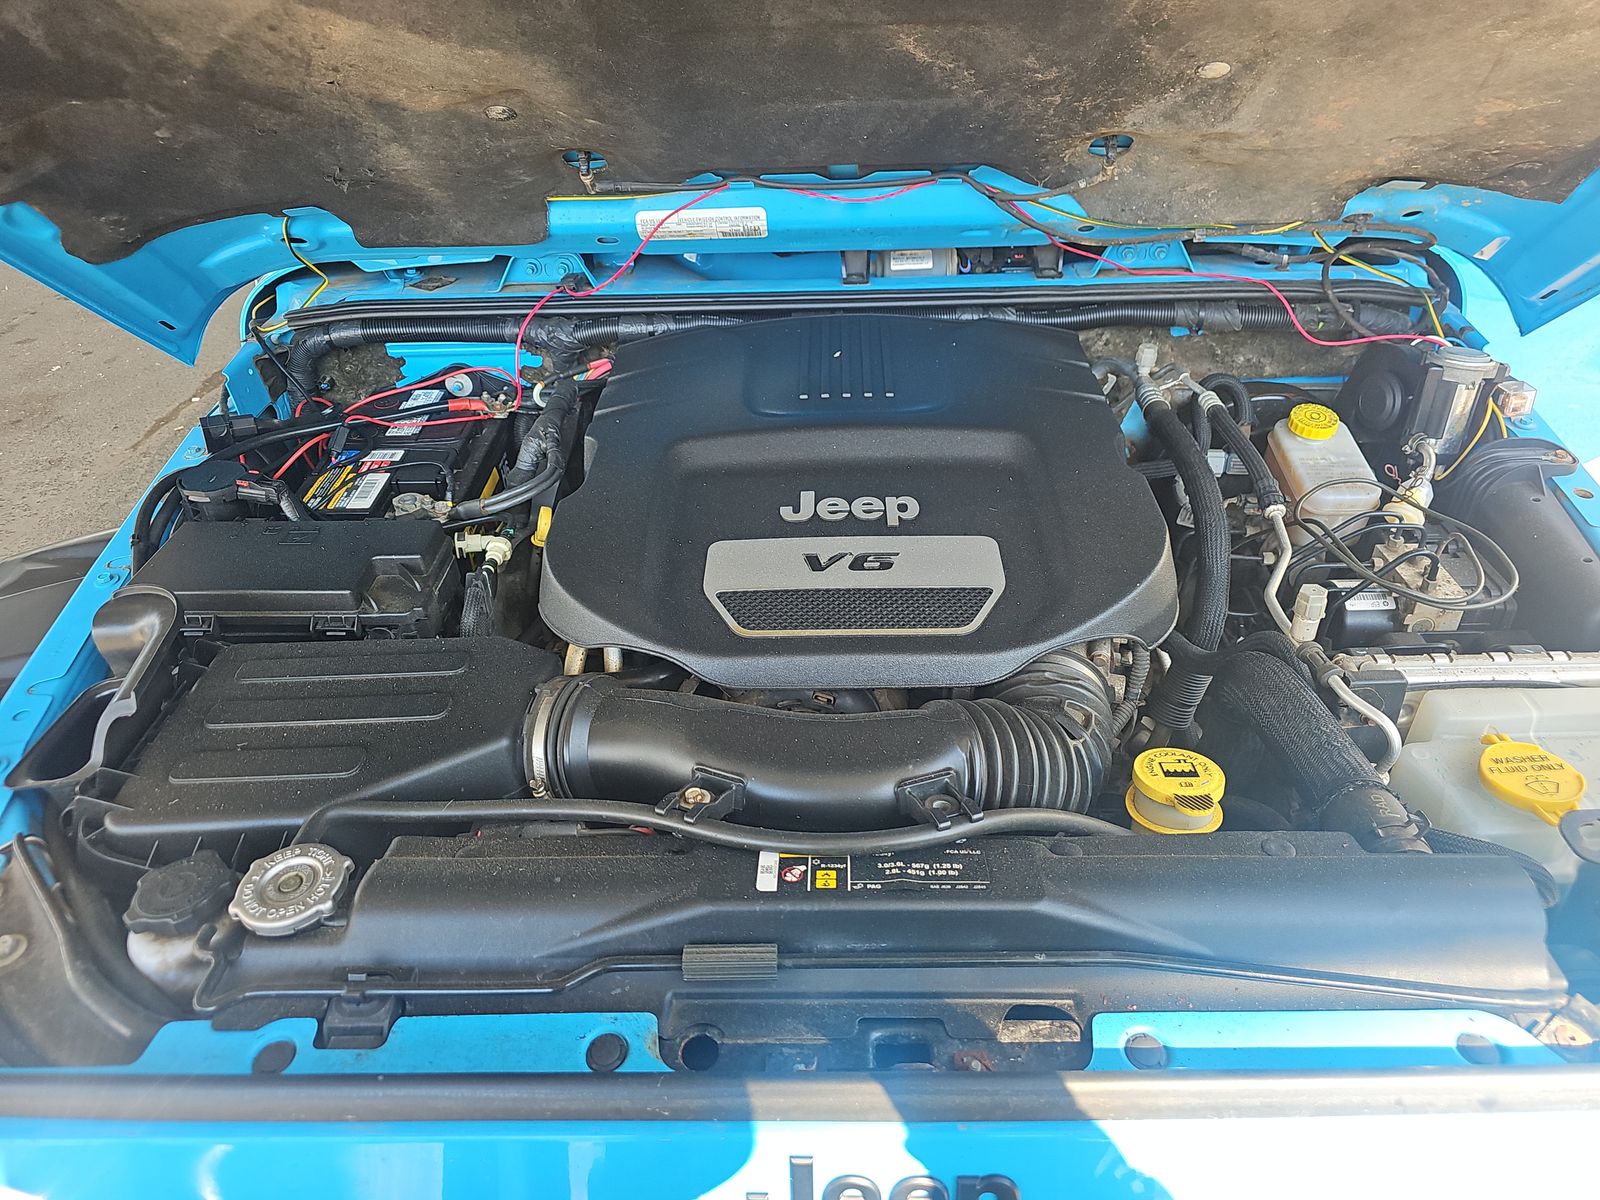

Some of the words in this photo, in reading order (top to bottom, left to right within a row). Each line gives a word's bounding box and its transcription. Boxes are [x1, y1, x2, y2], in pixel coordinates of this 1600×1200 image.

[779, 490, 921, 527] Jeep
[802, 551, 902, 573] V6
[1146, 757, 1159, 777] ENGINE
[1154, 751, 1199, 762] COOLANT
[1199, 762, 1214, 778] ONLY
[1488, 764, 1529, 775] FLUID
[1531, 762, 1567, 772] ONLY
[1490, 754, 1551, 765] WASHER
[264, 848, 302, 868] KEEP
[307, 847, 335, 865] TIGHT
[267, 901, 306, 919] OPEN
[306, 883, 331, 904] HOT
